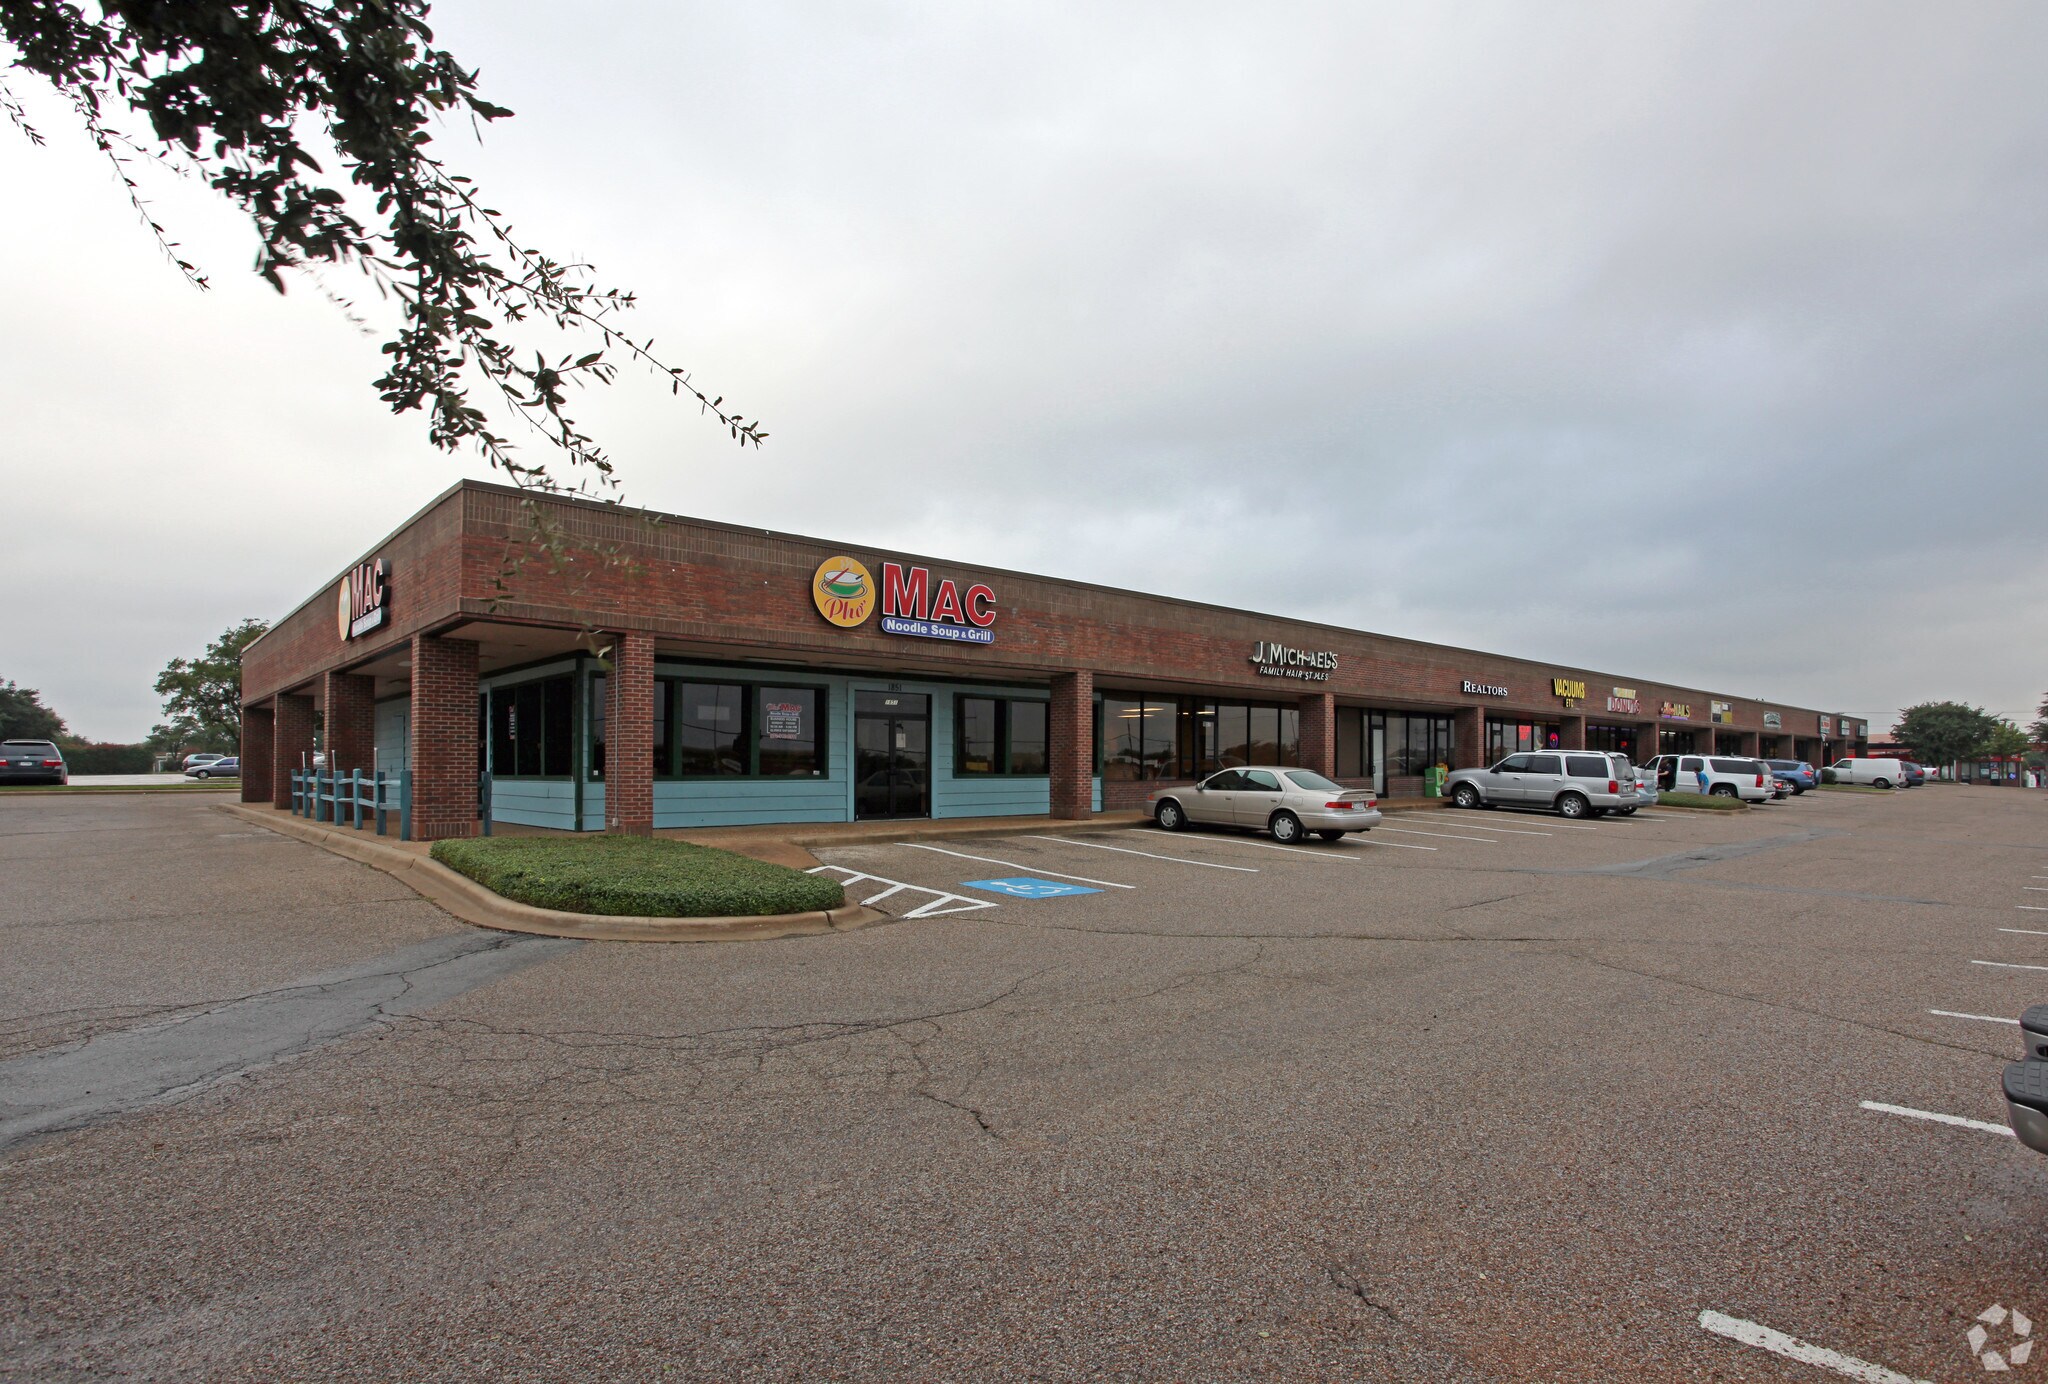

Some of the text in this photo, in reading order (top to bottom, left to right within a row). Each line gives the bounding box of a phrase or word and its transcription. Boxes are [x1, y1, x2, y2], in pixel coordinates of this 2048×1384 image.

[351, 558, 384, 621] MAC
[883, 562, 996, 627] MAC
[886, 619, 991, 642] Noodle Soup & Grill
[1252, 641, 1266, 663] J.
[1259, 666, 1284, 676] FAMILY
[1286, 669, 1303, 678] HAIR
[1553, 678, 1585, 699] VACUUMS
[1565, 698, 1574, 708] ETC
